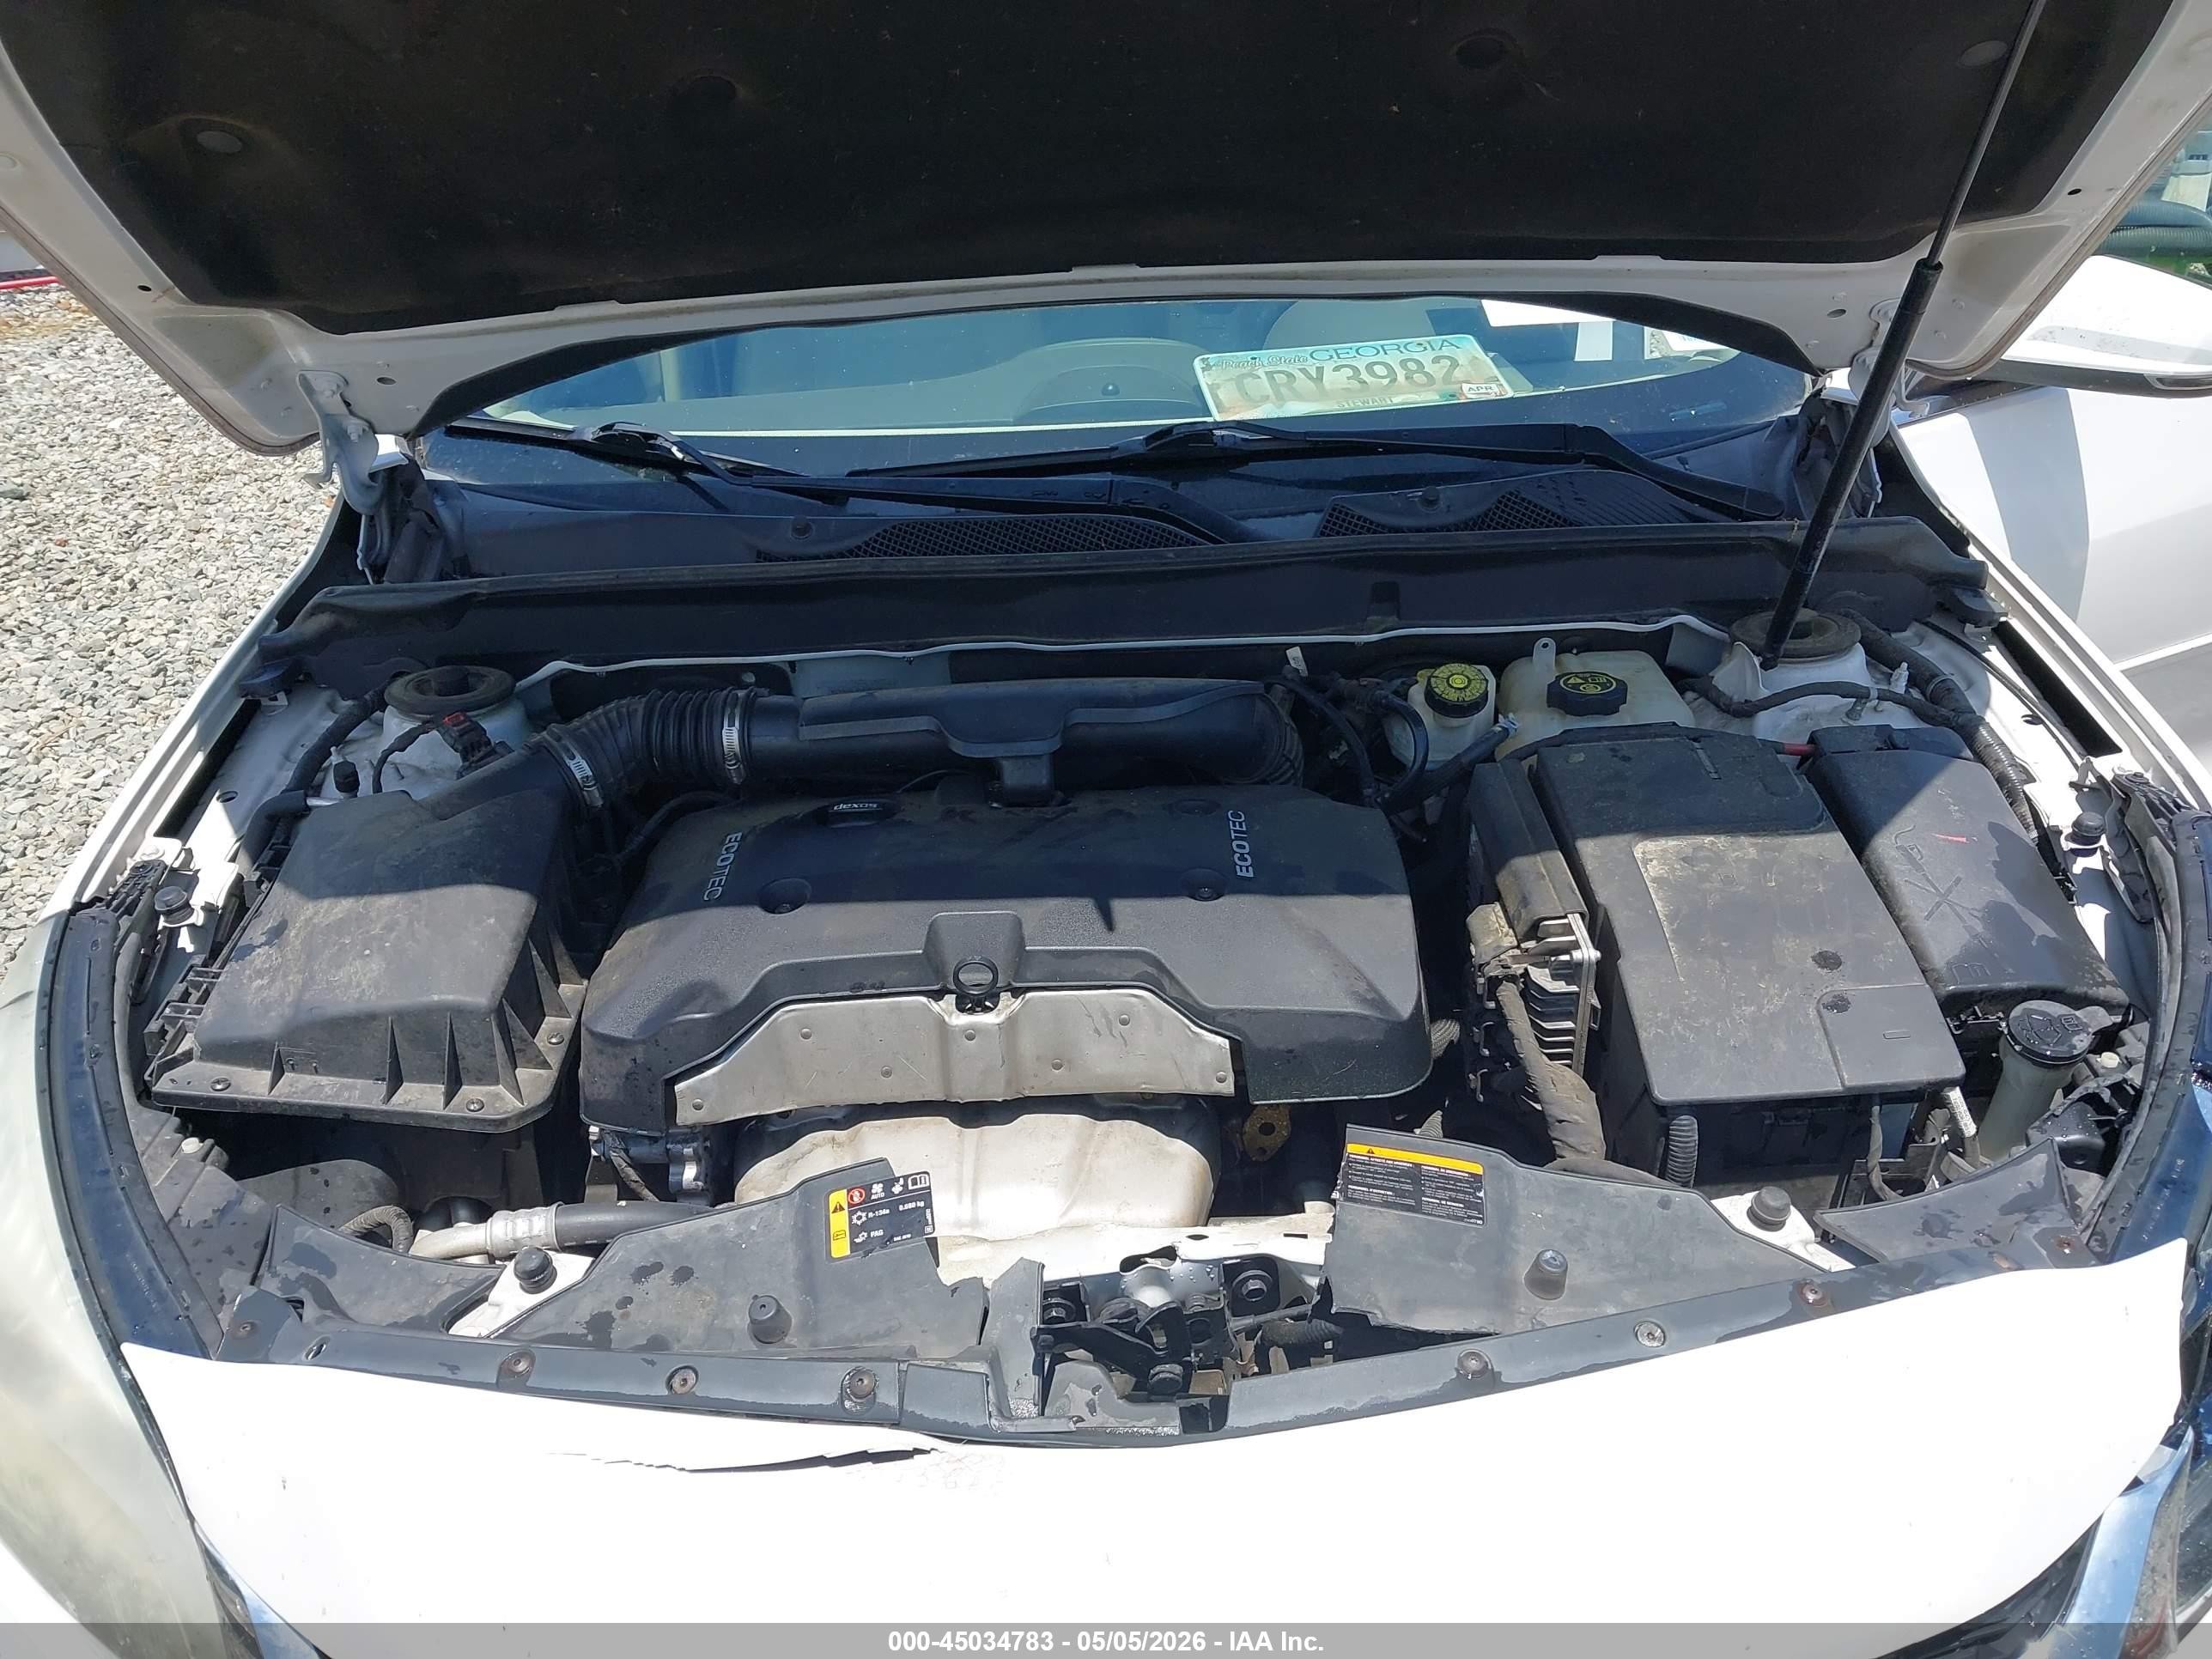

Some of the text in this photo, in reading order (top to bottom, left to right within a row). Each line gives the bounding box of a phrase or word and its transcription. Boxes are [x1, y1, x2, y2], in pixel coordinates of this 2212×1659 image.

[1310, 339, 1461, 362] GEORGIA
[1221, 355, 1308, 370] Peach State
[1235, 355, 1465, 407] CRY3982
[1337, 397, 1395, 408] STEWART
[834, 802, 878, 811] dexos
[1227, 810, 1255, 878] ECOTEC
[703, 831, 743, 901] ECOTEC
[871, 1192, 884, 1200] AUTO
[870, 1229, 884, 1238] PAG
